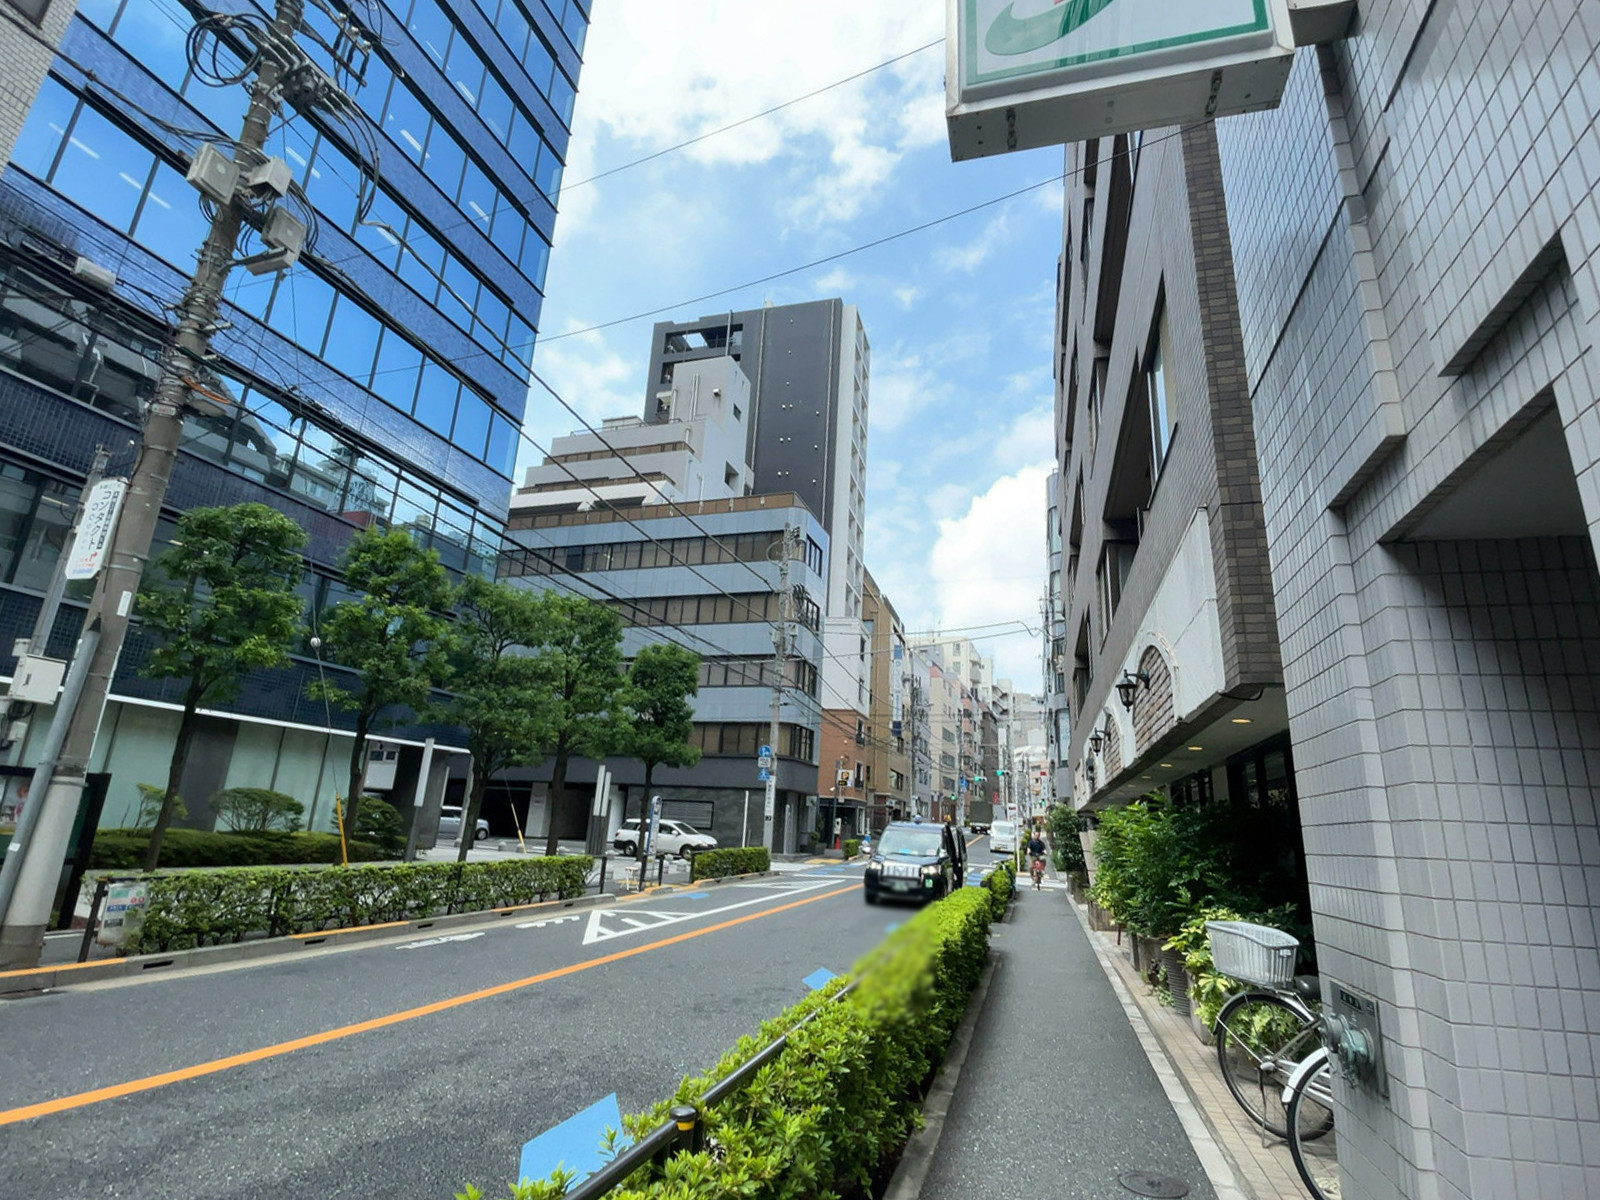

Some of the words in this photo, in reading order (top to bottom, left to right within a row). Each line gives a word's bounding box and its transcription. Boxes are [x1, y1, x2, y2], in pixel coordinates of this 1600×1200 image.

[88, 491, 112, 550] コンタクト
